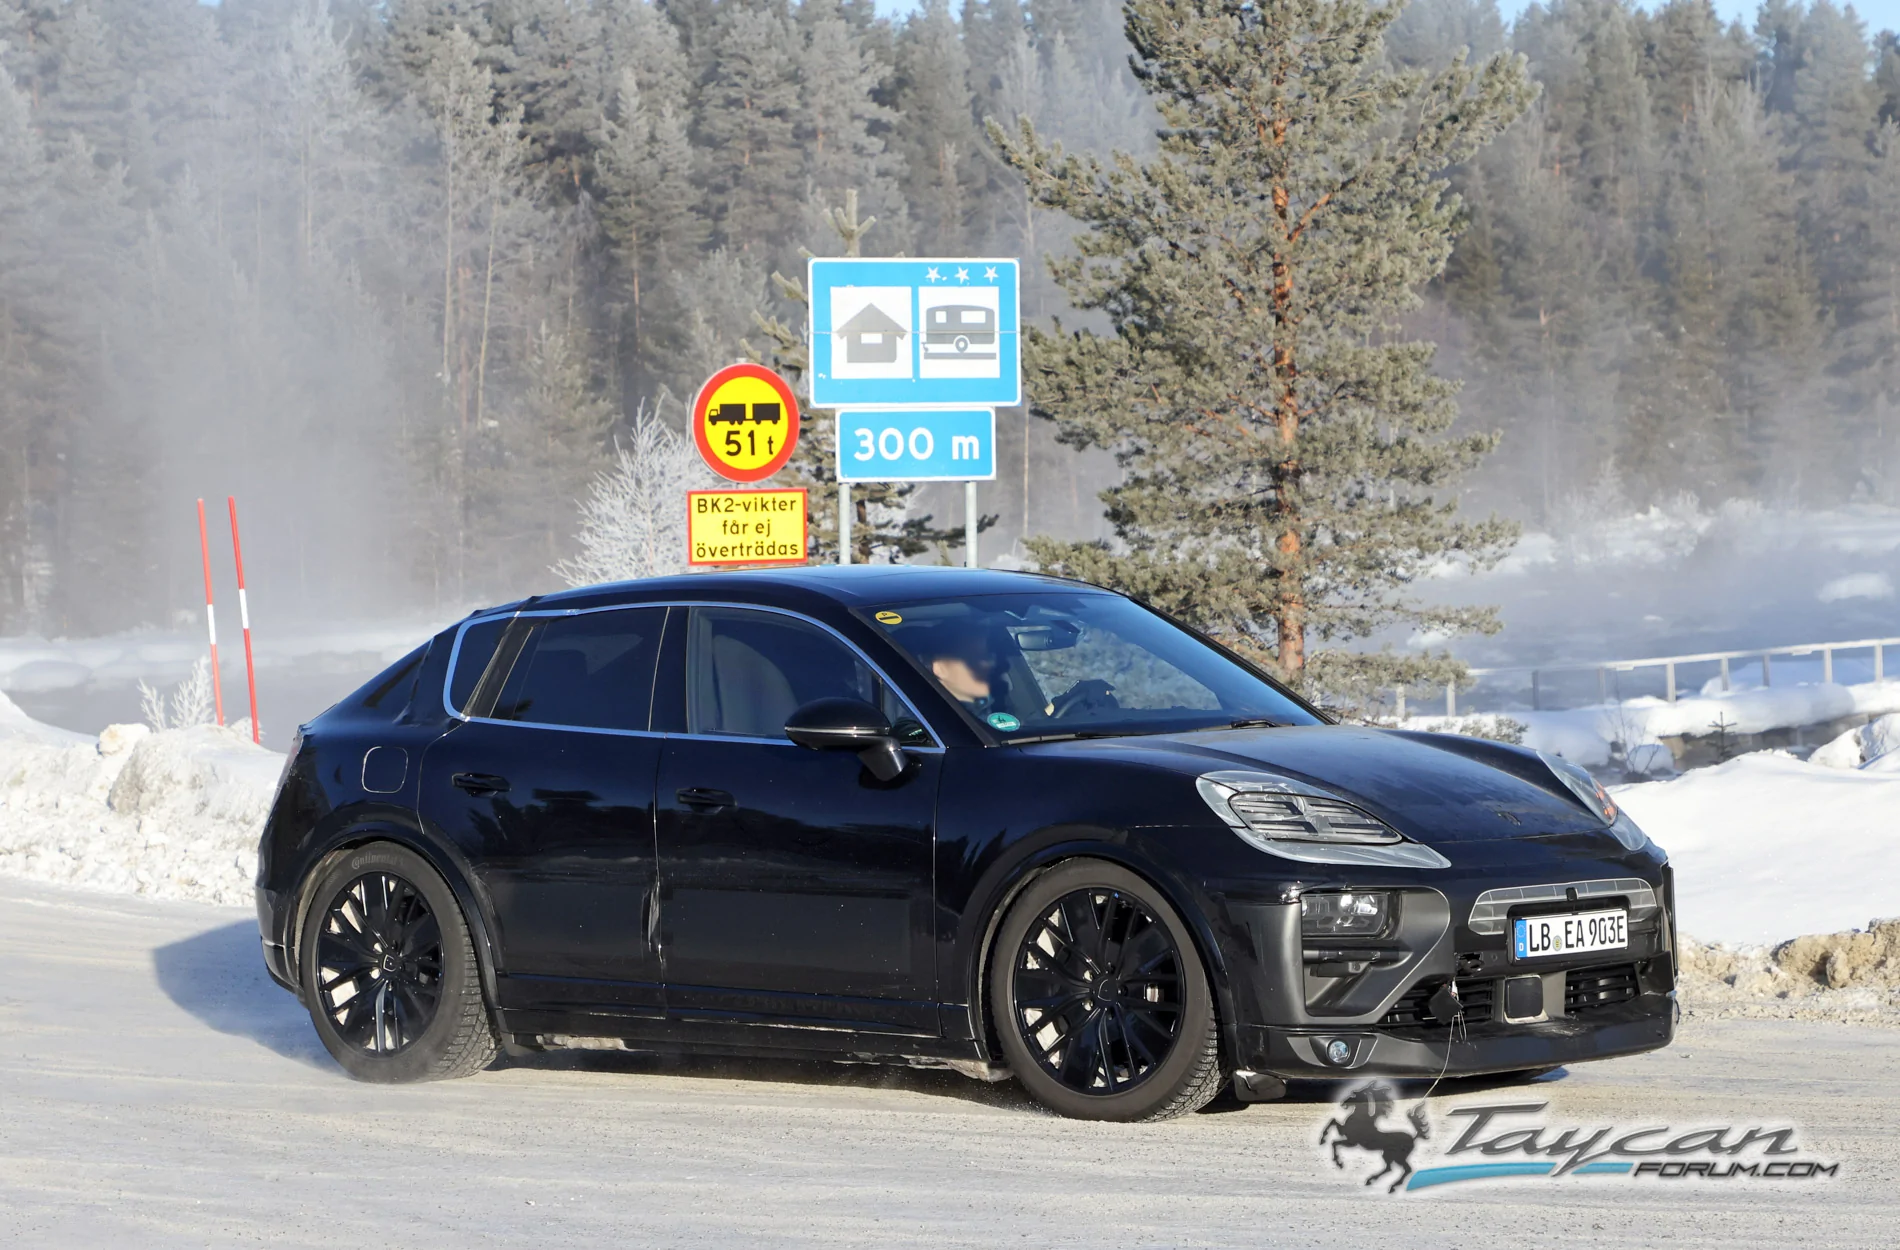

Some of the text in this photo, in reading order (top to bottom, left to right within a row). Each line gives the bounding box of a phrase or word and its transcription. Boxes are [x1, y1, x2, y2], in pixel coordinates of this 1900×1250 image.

[725, 430, 774, 456] 51 t
[854, 427, 979, 461] 300 m
[697, 496, 797, 514] BK2-vikter
[722, 519, 771, 537] får ej
[696, 541, 799, 558] överträdas
[1529, 915, 1625, 952] LB EA 903E
